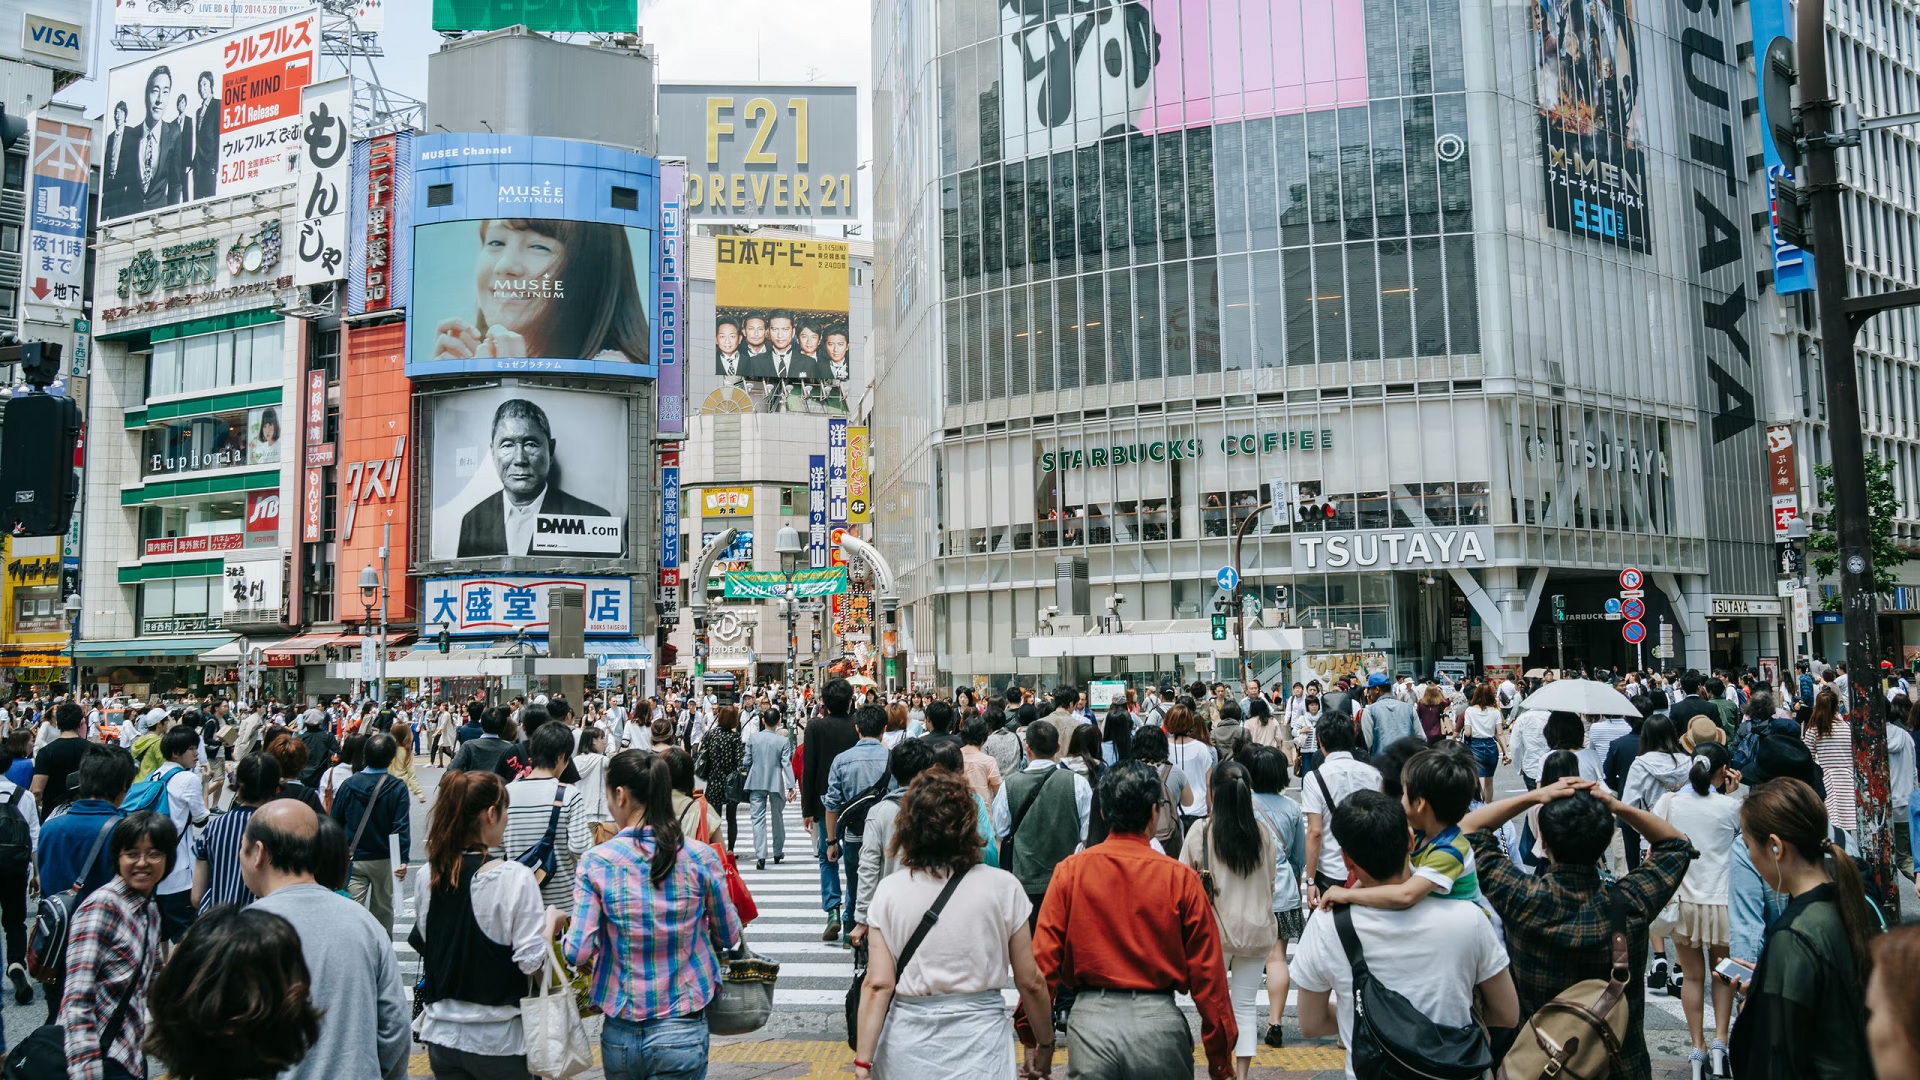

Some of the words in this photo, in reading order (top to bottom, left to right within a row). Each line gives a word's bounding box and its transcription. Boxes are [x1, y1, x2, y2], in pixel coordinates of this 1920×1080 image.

[199, 3, 212, 13] LIVE
[224, 4, 229, 13] &
[230, 4, 243, 14] DVD
[244, 4, 277, 14] 2014.5.28
[31, 25, 80, 51] VISA
[224, 16, 314, 69] ウルフルズ
[224, 84, 247, 106] ONE
[250, 75, 281, 99] MIND
[223, 103, 247, 129] 5.21
[247, 103, 280, 122] Release
[706, 97, 808, 164] F21
[35, 122, 91, 180] 本
[421, 148, 459, 161] MUSEE
[463, 145, 512, 156] Channel
[221, 160, 245, 184] 5.20
[1547, 143, 1643, 196] X-MEN
[37, 188, 48, 215] BOOK
[299, 101, 347, 276] もんじゃ
[498, 196, 564, 204] PLATINUM
[689, 174, 811, 207] OREVER
[819, 174, 851, 207] 21
[36, 216, 82, 230] ブックファースト
[1573, 198, 1617, 238] 5.30
[32, 235, 83, 258] 夜11時
[662, 193, 682, 283] Taisei
[41, 255, 72, 275] まで
[717, 238, 815, 267] 日本ダービー
[53, 282, 81, 302] 地下
[493, 291, 564, 299] PLATINUM
[661, 291, 676, 366] neon
[497, 361, 562, 369] ミュゼプラチナム
[311, 374, 323, 441] お好み焼
[661, 404, 680, 413] 3719
[662, 395, 680, 404] (03)
[661, 412, 680, 421] 2468
[152, 449, 242, 472] Euphoria
[1041, 438, 1204, 473] STARBUCKS
[1220, 429, 1334, 458] COFFEE
[1569, 438, 1669, 477] TSUTAYA
[830, 423, 848, 521] 洋服の青山
[343, 434, 407, 541] クスリ
[249, 495, 280, 524] JTB
[306, 470, 319, 538] もんじゃ焼
[810, 466, 826, 568] 洋服の青山
[851, 501, 866, 512] 4F
[536, 517, 619, 536] DMM.com
[664, 474, 677, 562] 大盛堂商事ビル
[147, 541, 174, 553] 国内旅行
[179, 538, 207, 550] 海外旅行
[213, 534, 241, 543] ハネムーン
[1299, 531, 1487, 568] TSUTAYA
[432, 586, 621, 623] 大盛堂店
[664, 587, 677, 613] 牛繁
[1712, 600, 1749, 613] TSUTAYA
